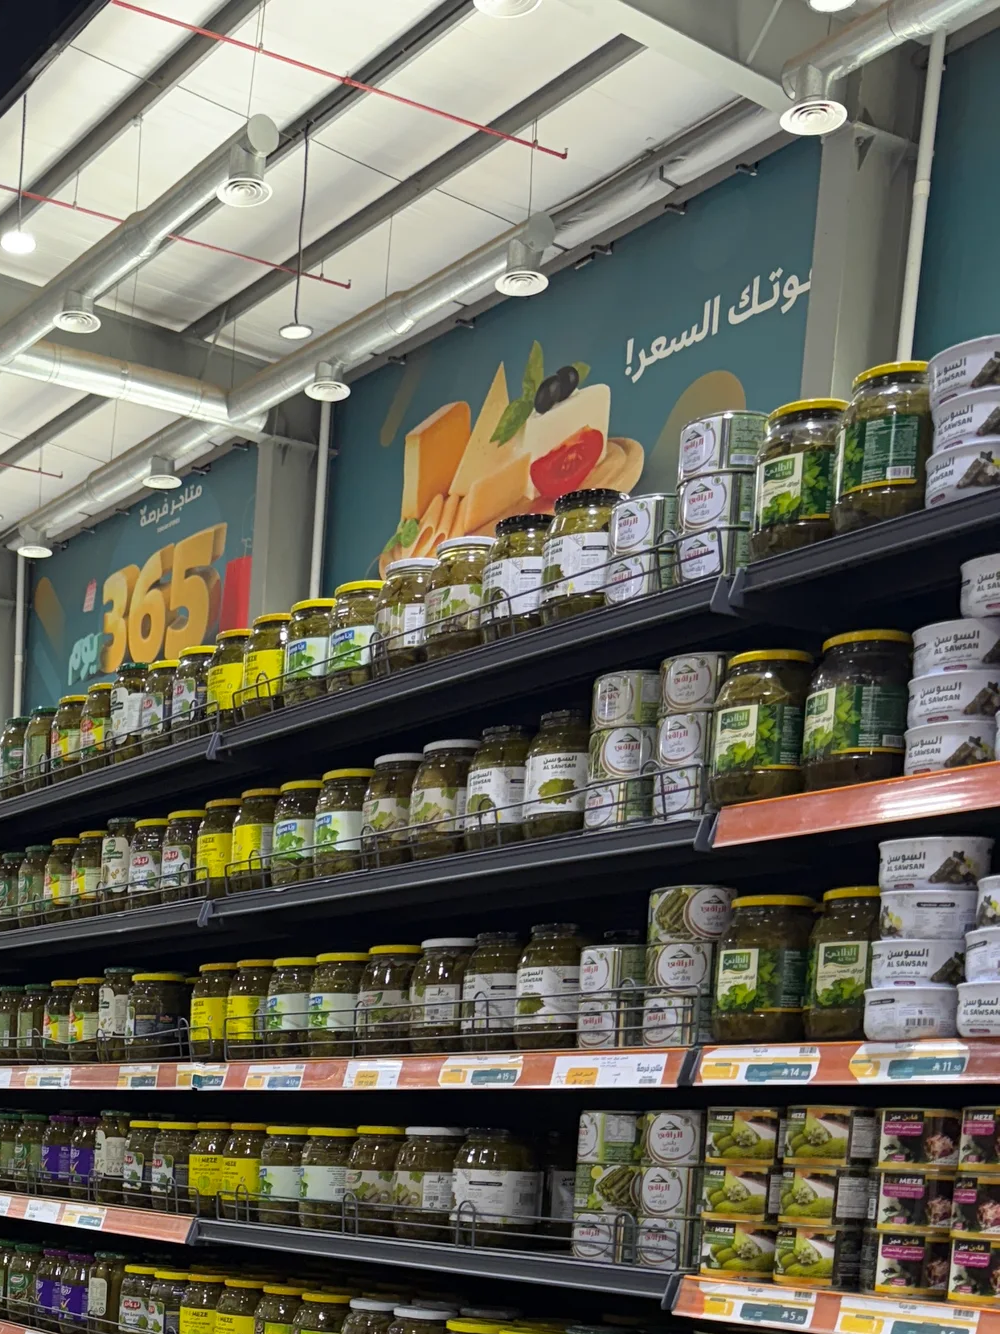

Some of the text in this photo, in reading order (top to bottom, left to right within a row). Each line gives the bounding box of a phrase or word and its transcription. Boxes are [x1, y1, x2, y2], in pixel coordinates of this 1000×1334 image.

[625, 295, 720, 383] السعر!
[944, 416, 973, 432] SAWSAN
[170, 484, 203, 516] متاجر
[100, 522, 227, 673] 365
[934, 630, 980, 646] السوسن
[934, 642, 979, 655] AL SAWSAN
[68, 632, 103, 686] يوم
[920, 682, 962, 699] السوسن
[928, 694, 961, 705] SAWSAN
[908, 736, 942, 751] السوسن
[915, 747, 941, 757] SAWSAN
[543, 755, 578, 765] السوسن
[886, 851, 926, 864] السوسن
[895, 863, 926, 871] SAWSAN
[887, 948, 929, 960] السوسن
[886, 960, 928, 968] AL SAWSAN
[650, 1064, 663, 1073] متاجر
[973, 1113, 994, 1121] MEZE
